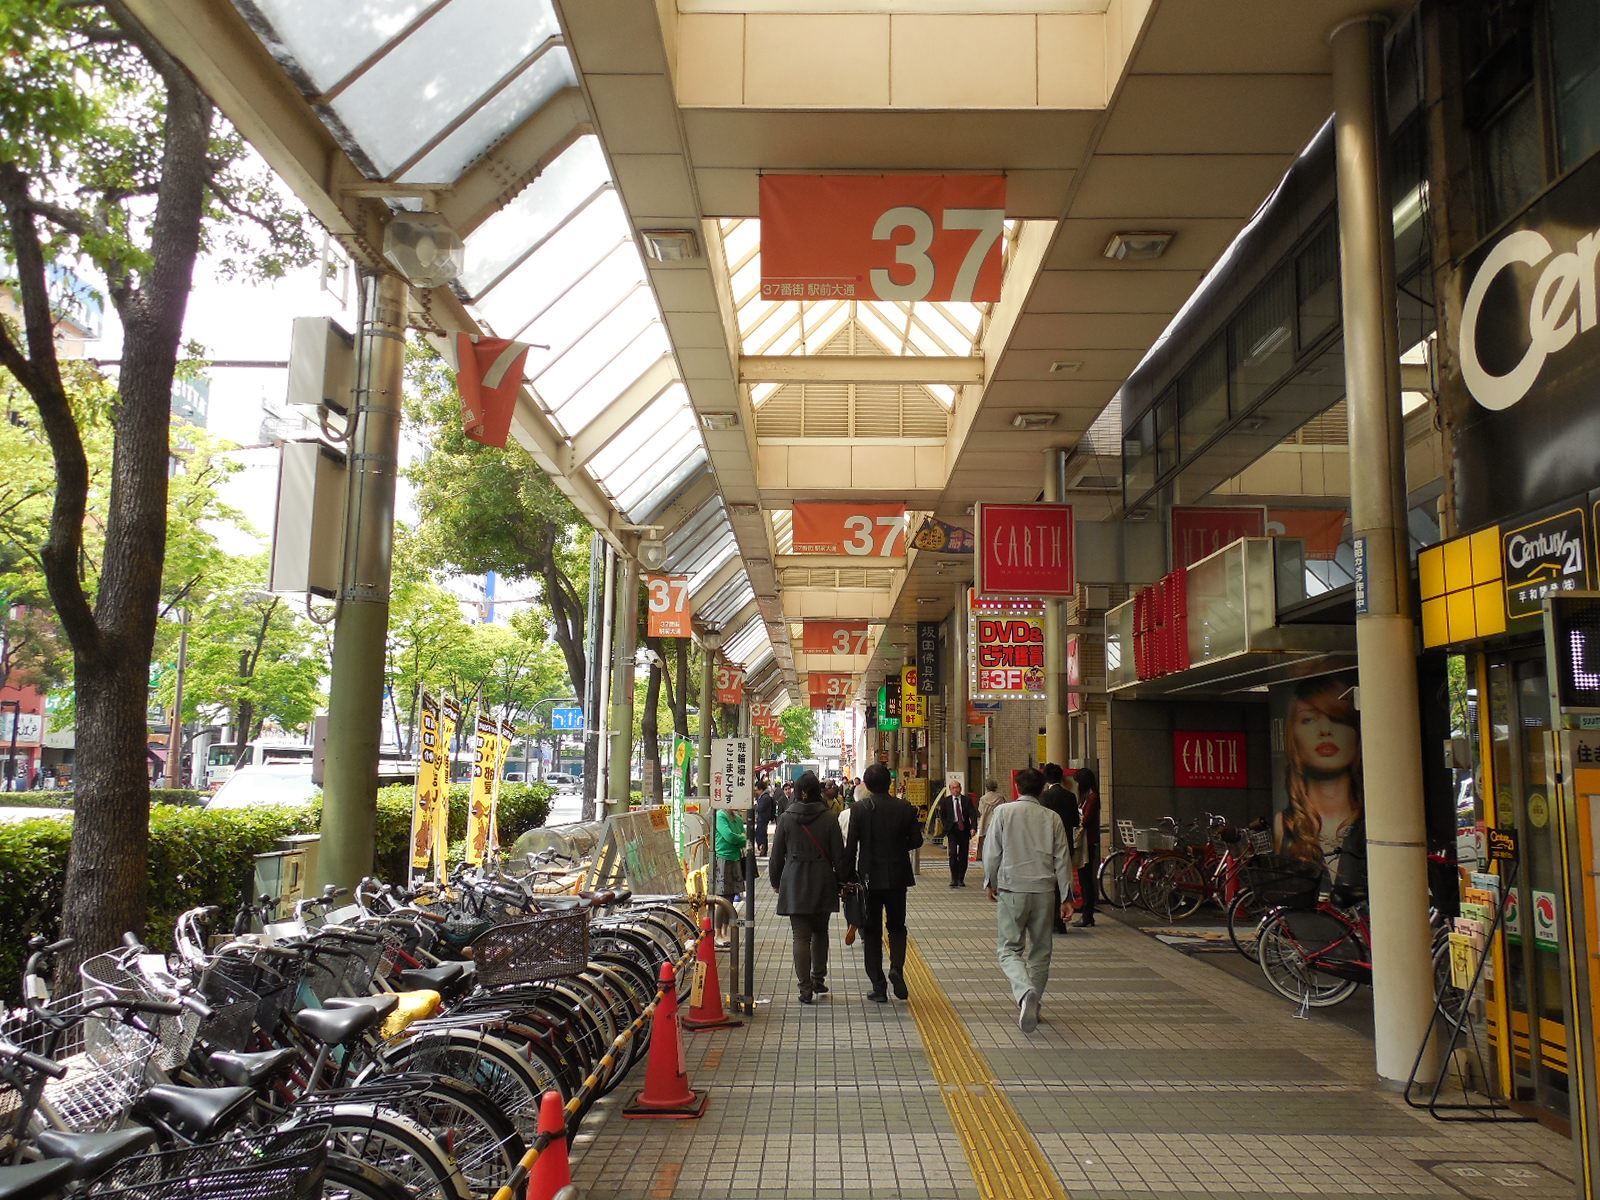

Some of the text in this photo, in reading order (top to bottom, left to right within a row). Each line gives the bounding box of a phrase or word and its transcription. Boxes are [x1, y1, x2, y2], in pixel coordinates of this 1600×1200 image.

[870, 206, 1005, 301] 37
[763, 284, 855, 296] 37番街 駅前大通
[843, 515, 905, 557] 37
[993, 526, 1062, 568] EARTH
[1509, 530, 1582, 575] Century 21
[648, 579, 689, 613] 37
[831, 629, 869, 656] 37
[979, 620, 1044, 643] DVD&
[716, 669, 743, 690] 37
[827, 678, 853, 695] 37
[990, 670, 1021, 689] 3F
[751, 703, 771, 717] 37
[905, 692, 916, 724] 太陽軒
[737, 742, 747, 787] 駐輪場は
[1182, 739, 1238, 773] EARTH
[725, 743, 734, 804] ここまでです
